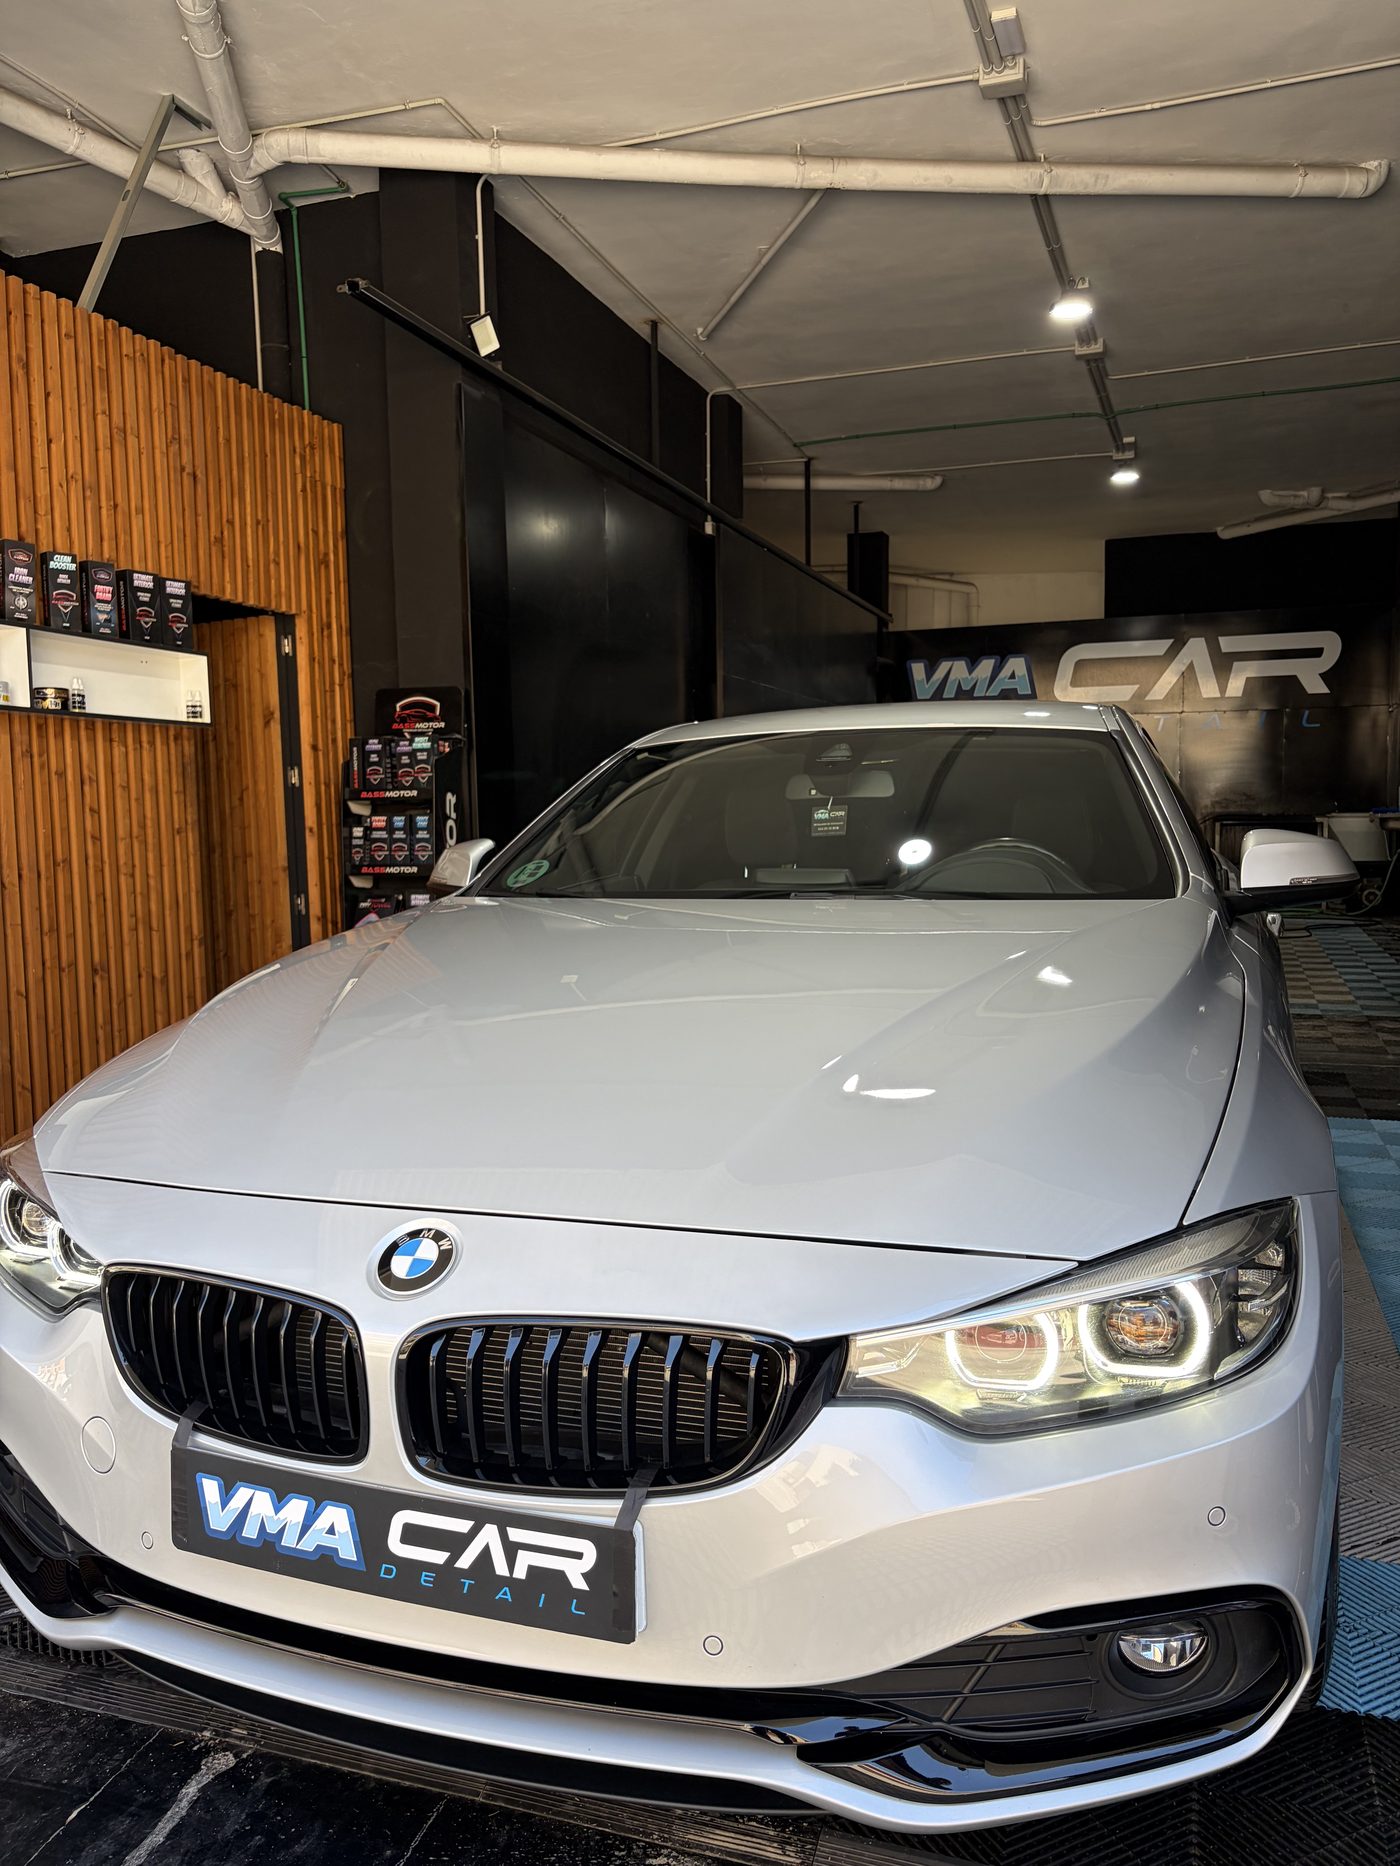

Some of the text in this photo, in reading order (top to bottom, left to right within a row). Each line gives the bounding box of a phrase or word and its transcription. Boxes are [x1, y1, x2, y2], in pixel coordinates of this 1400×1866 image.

[53, 554, 73, 563] CLEAN
[49, 561, 77, 571] BOOSTER
[8, 573, 33, 584] CLEANER
[907, 630, 1342, 701] VMA CAR
[392, 722, 446, 730] BASSMOTOR
[1154, 710, 1321, 732] TAIL
[360, 789, 418, 798] BASSMOTOR
[360, 866, 418, 874] BASSMOTOR
[395, 1228, 453, 1251] BMW
[196, 1473, 597, 1591] VMA CAR
[380, 1564, 586, 1615] DETAIL
